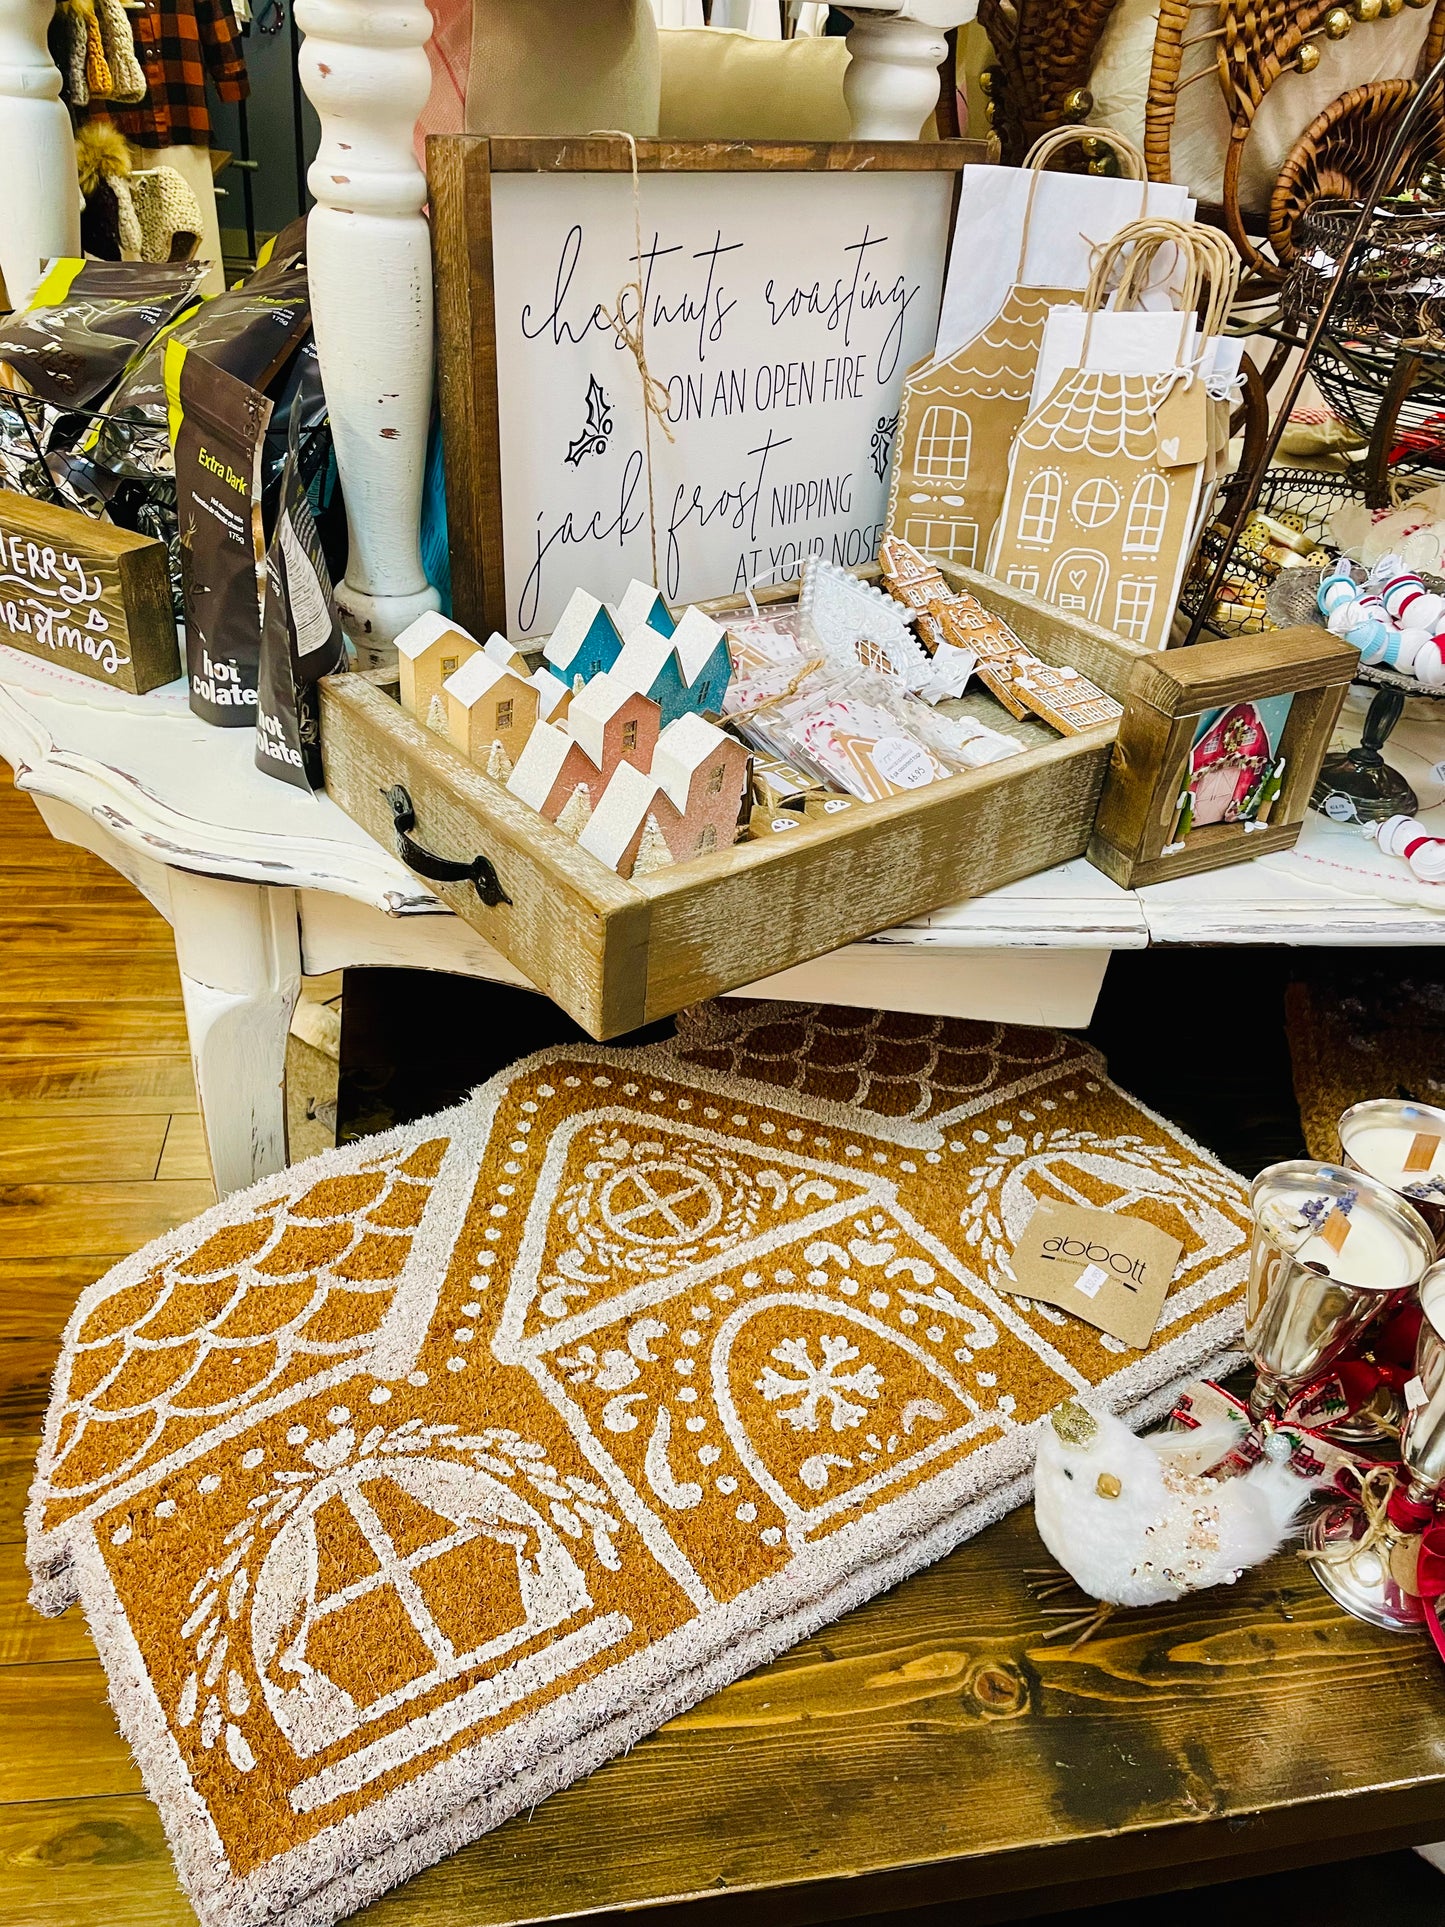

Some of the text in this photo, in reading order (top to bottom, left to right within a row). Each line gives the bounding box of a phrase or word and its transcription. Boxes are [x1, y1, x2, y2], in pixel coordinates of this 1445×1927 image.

[140, 314, 157, 325] 175g
[272, 314, 289, 327] 175g
[521, 224, 920, 385] chestnuts roasting
[666, 354, 867, 423] ON AN OPEN FIRE
[198, 447, 248, 496] Extra Dark
[228, 530, 245, 545] 175g
[518, 450, 645, 632] jack
[667, 428, 793, 600] frost
[771, 473, 854, 528] NIPPING
[733, 549, 763, 594] AT
[831, 523, 884, 567] NOSE
[203, 649, 242, 683] hot
[1042, 1235, 1147, 1285] abbott
